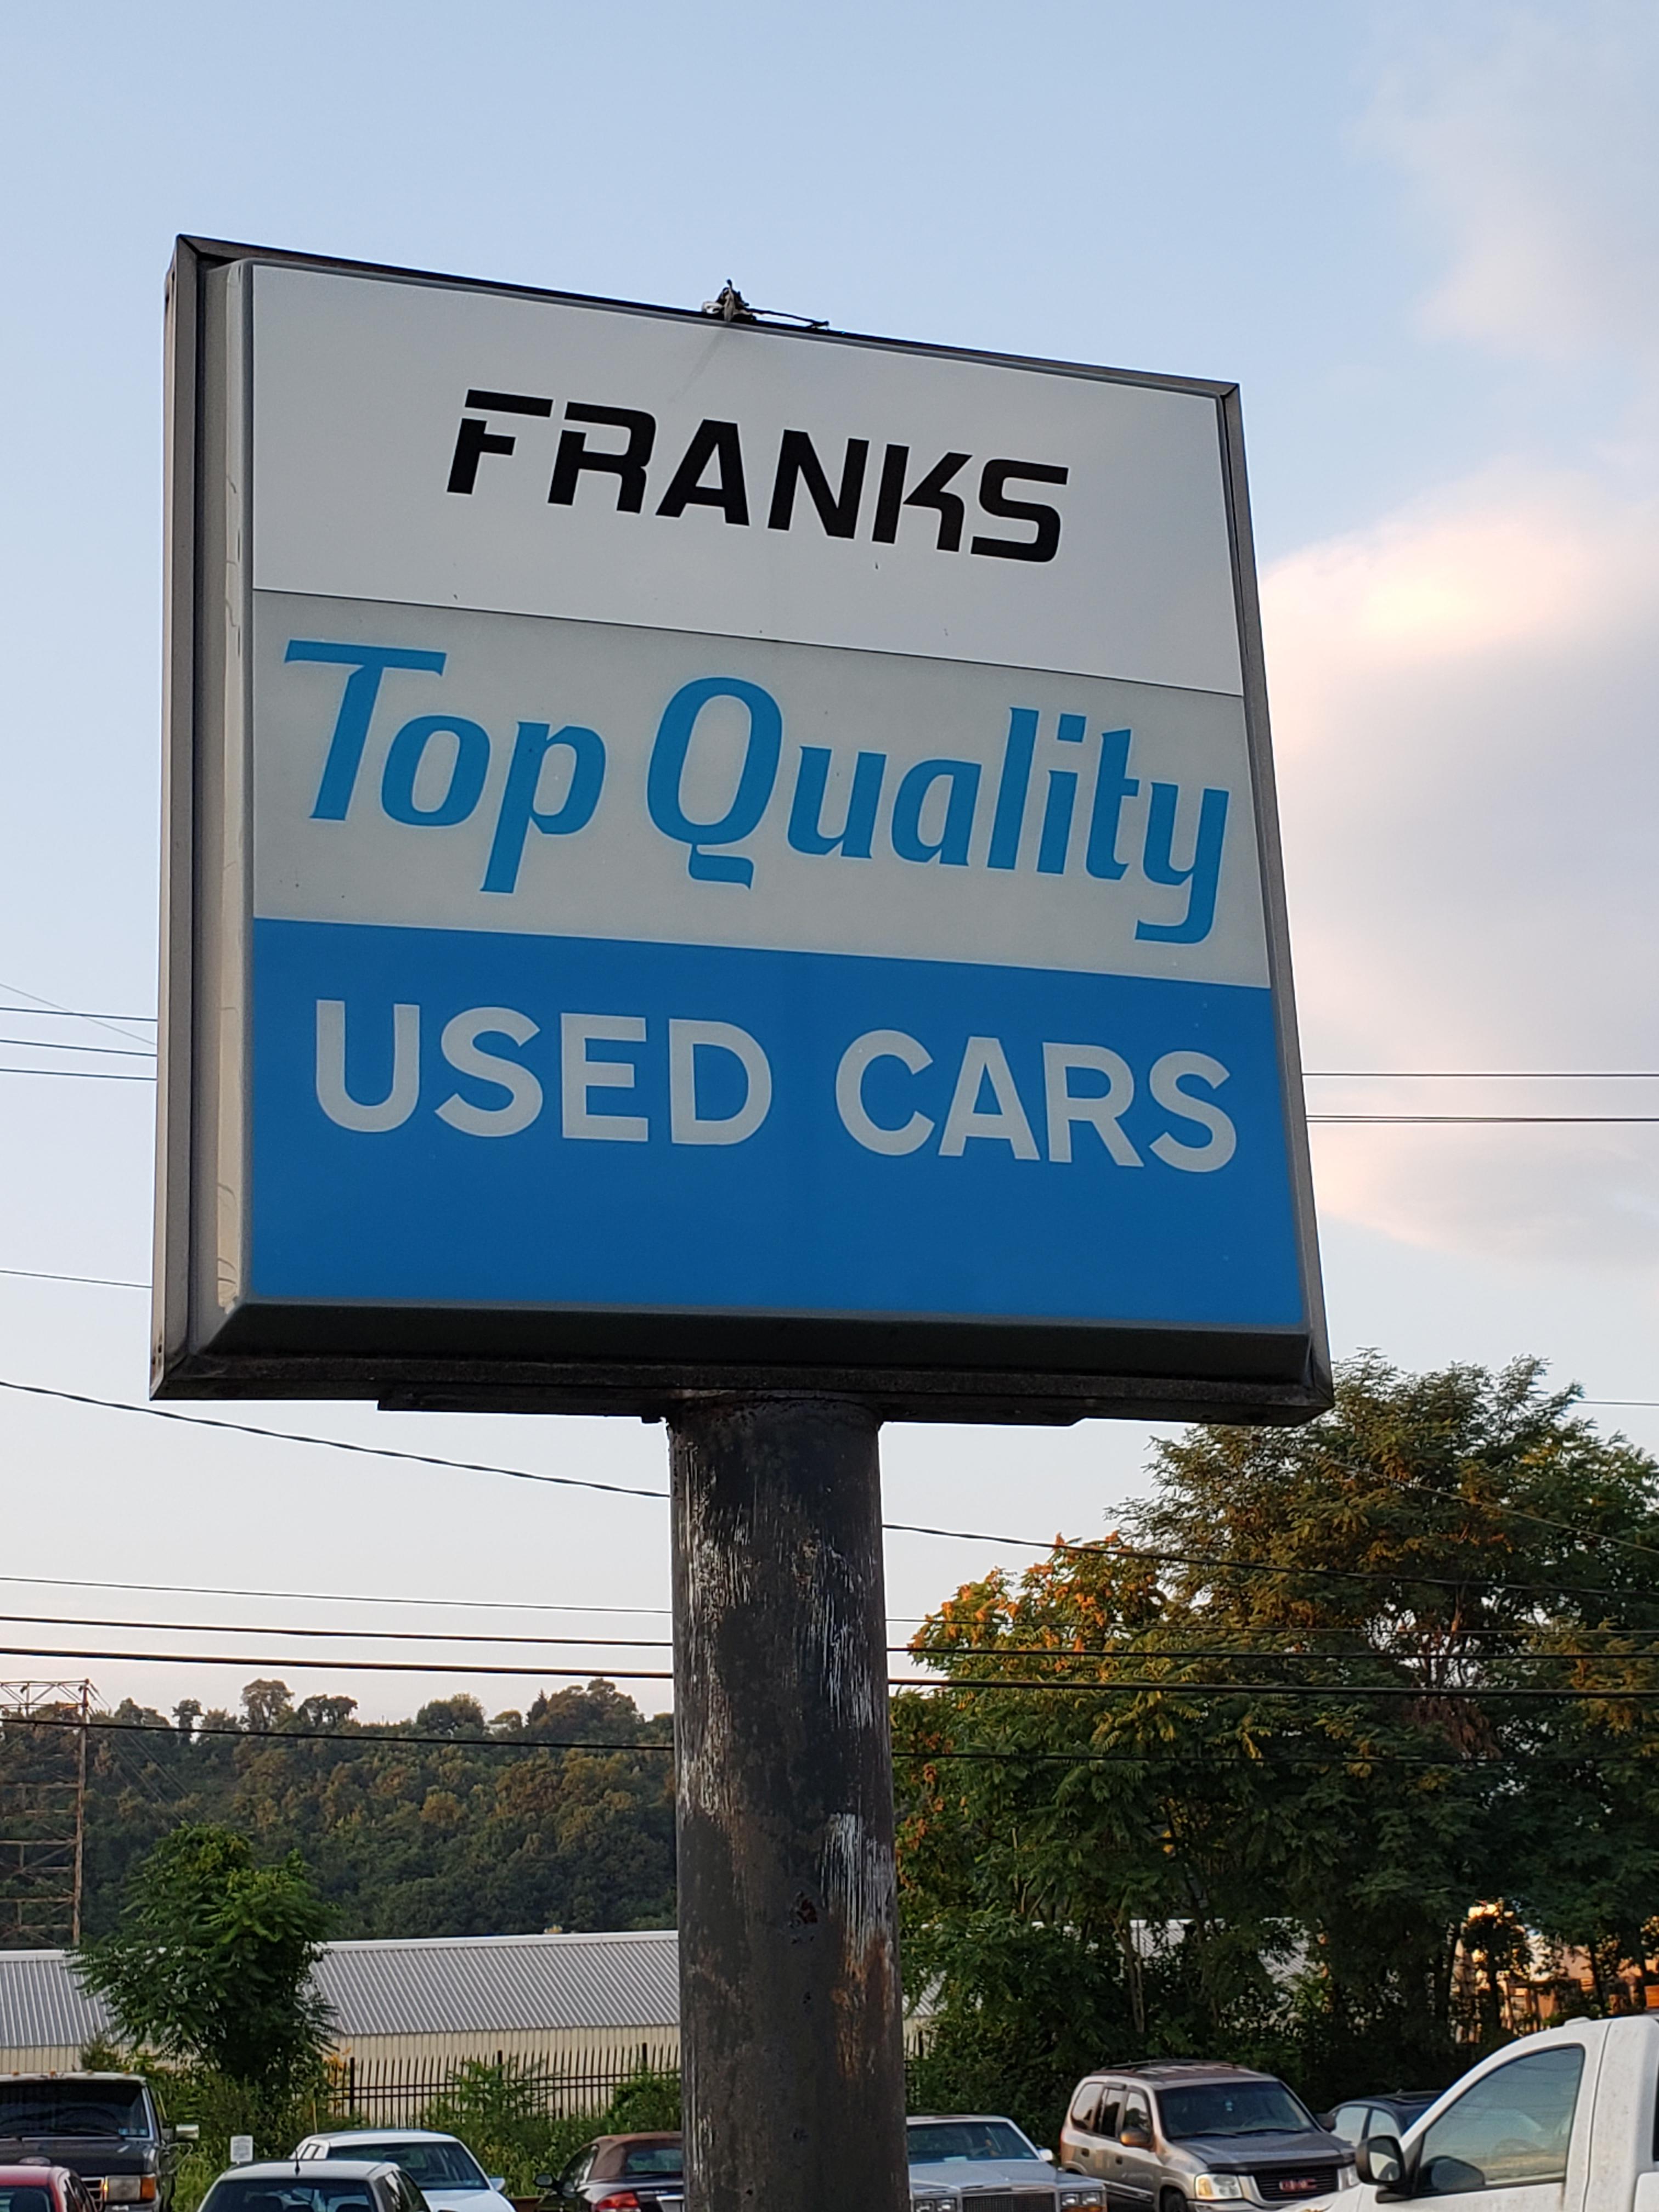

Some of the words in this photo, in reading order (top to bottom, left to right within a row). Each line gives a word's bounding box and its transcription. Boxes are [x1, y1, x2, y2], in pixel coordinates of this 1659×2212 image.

[447, 389, 1069, 562] FRANKS
[285, 640, 606, 894] Top
[647, 677, 1229, 945] Quality
[316, 1000, 772, 1146] USED
[835, 1029, 1237, 1173] CARS
